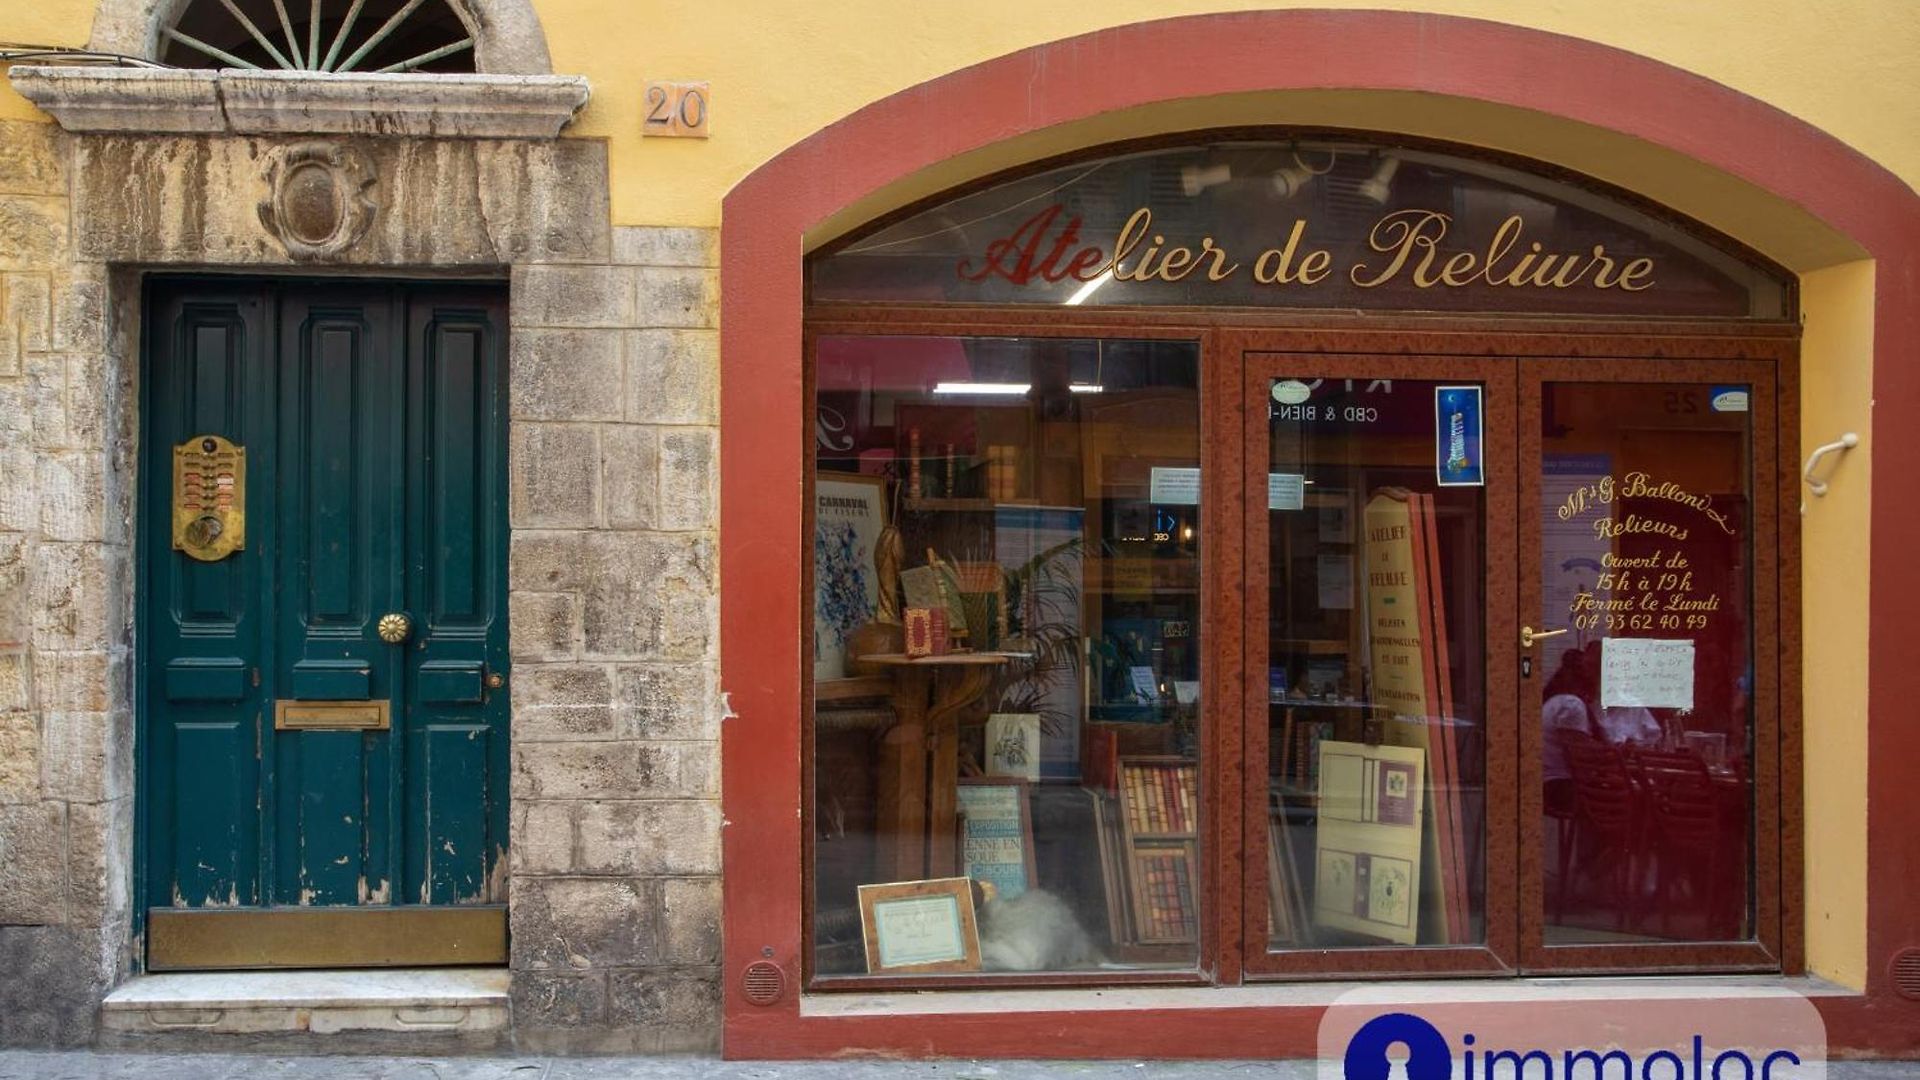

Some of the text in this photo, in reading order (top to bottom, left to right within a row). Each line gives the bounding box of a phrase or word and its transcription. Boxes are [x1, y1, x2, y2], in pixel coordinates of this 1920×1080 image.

[645, 86, 706, 128] 20
[956, 203, 1658, 292] Atelier de Reliure
[818, 495, 869, 510] CARNAVAL
[1622, 471, 1723, 519] Balloni
[1593, 514, 1689, 541] Relieurs
[1601, 549, 1689, 569] Ouvert de
[1637, 575, 1650, 590] à
[1569, 591, 1720, 612] Fermé le Lundi
[1576, 614, 1708, 630] 04 93 62 40 49
